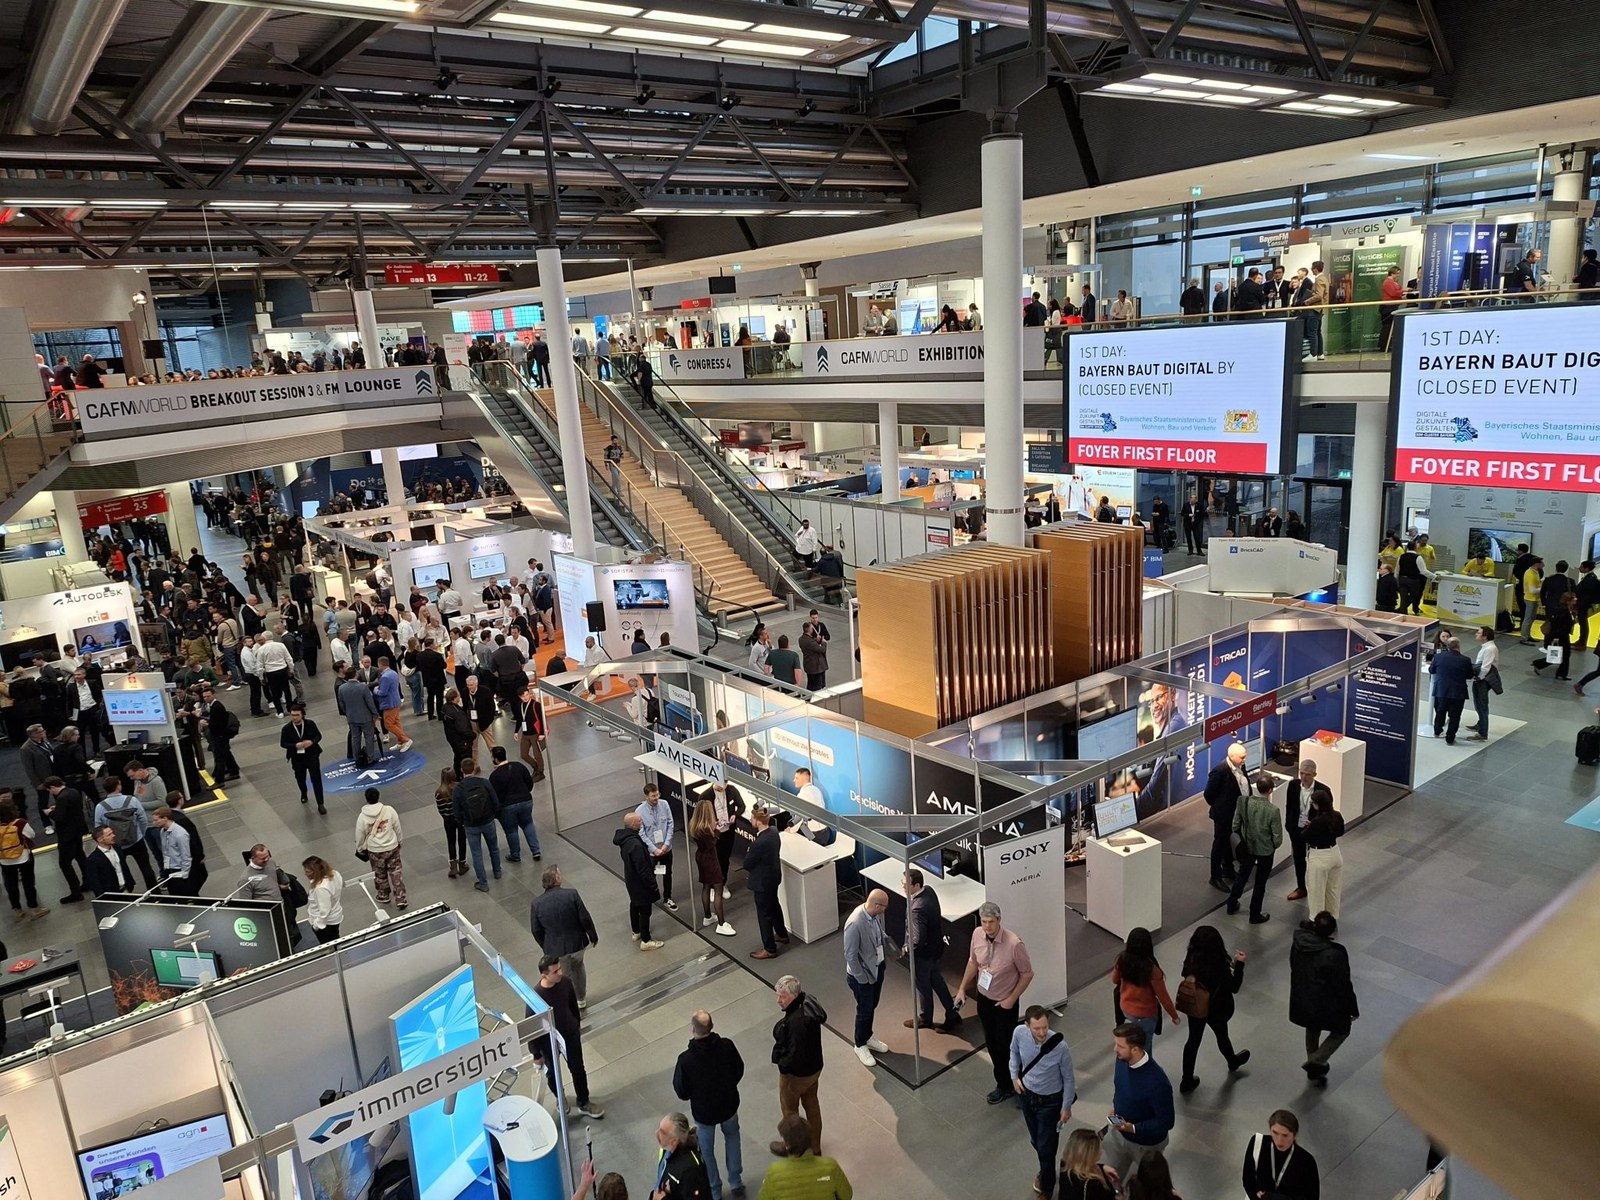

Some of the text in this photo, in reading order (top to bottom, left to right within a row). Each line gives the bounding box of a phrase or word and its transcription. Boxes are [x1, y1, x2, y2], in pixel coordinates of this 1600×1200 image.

[1342, 223, 1380, 236] VertiGIS
[1358, 253, 1382, 261] VertiGIS
[395, 274, 400, 282] 1
[426, 274, 437, 282] 13
[464, 273, 488, 281] 11-22
[1422, 329, 1500, 346] 1ST DAY:
[841, 345, 984, 364] CAFMWORLD EXHIBITION
[1079, 346, 1127, 358] 1ST DAY:
[687, 358, 731, 370] CONGRESS 4
[1079, 361, 1235, 377] BAYERN BAUT DIGITAL BY
[1419, 355, 1495, 370] BAYERN
[1502, 353, 1558, 369] BAUT
[1078, 382, 1173, 396] (CLOSED EVENT)
[1417, 377, 1578, 395] (CLOSED EVENT)
[86, 378, 402, 419] CAFMWORLD BREAKOUT SESSION 3 & FM LOUNGE
[1484, 421, 1540, 431] Bayerisches
[1521, 432, 1563, 441] Wohnen,
[1566, 434, 1586, 442] Bau
[1078, 444, 1217, 464] FOYER FIRST FLOOR
[483, 468, 492, 477] it
[1411, 457, 1480, 477] FOYER
[1486, 460, 1556, 480] FIRST
[134, 501, 148, 511] 2-5
[67, 589, 123, 604] AUTODESK
[1219, 647, 1247, 663] TRICAD
[1217, 700, 1273, 728] TRICAD Bentley
[658, 742, 720, 782] AMERIA
[850, 790, 896, 815] Decisions
[1000, 841, 1051, 865] SONY
[1011, 872, 1041, 886] AMERIA
[177, 1129, 201, 1139] agn
[98, 1145, 157, 1165] unsere Kunden
